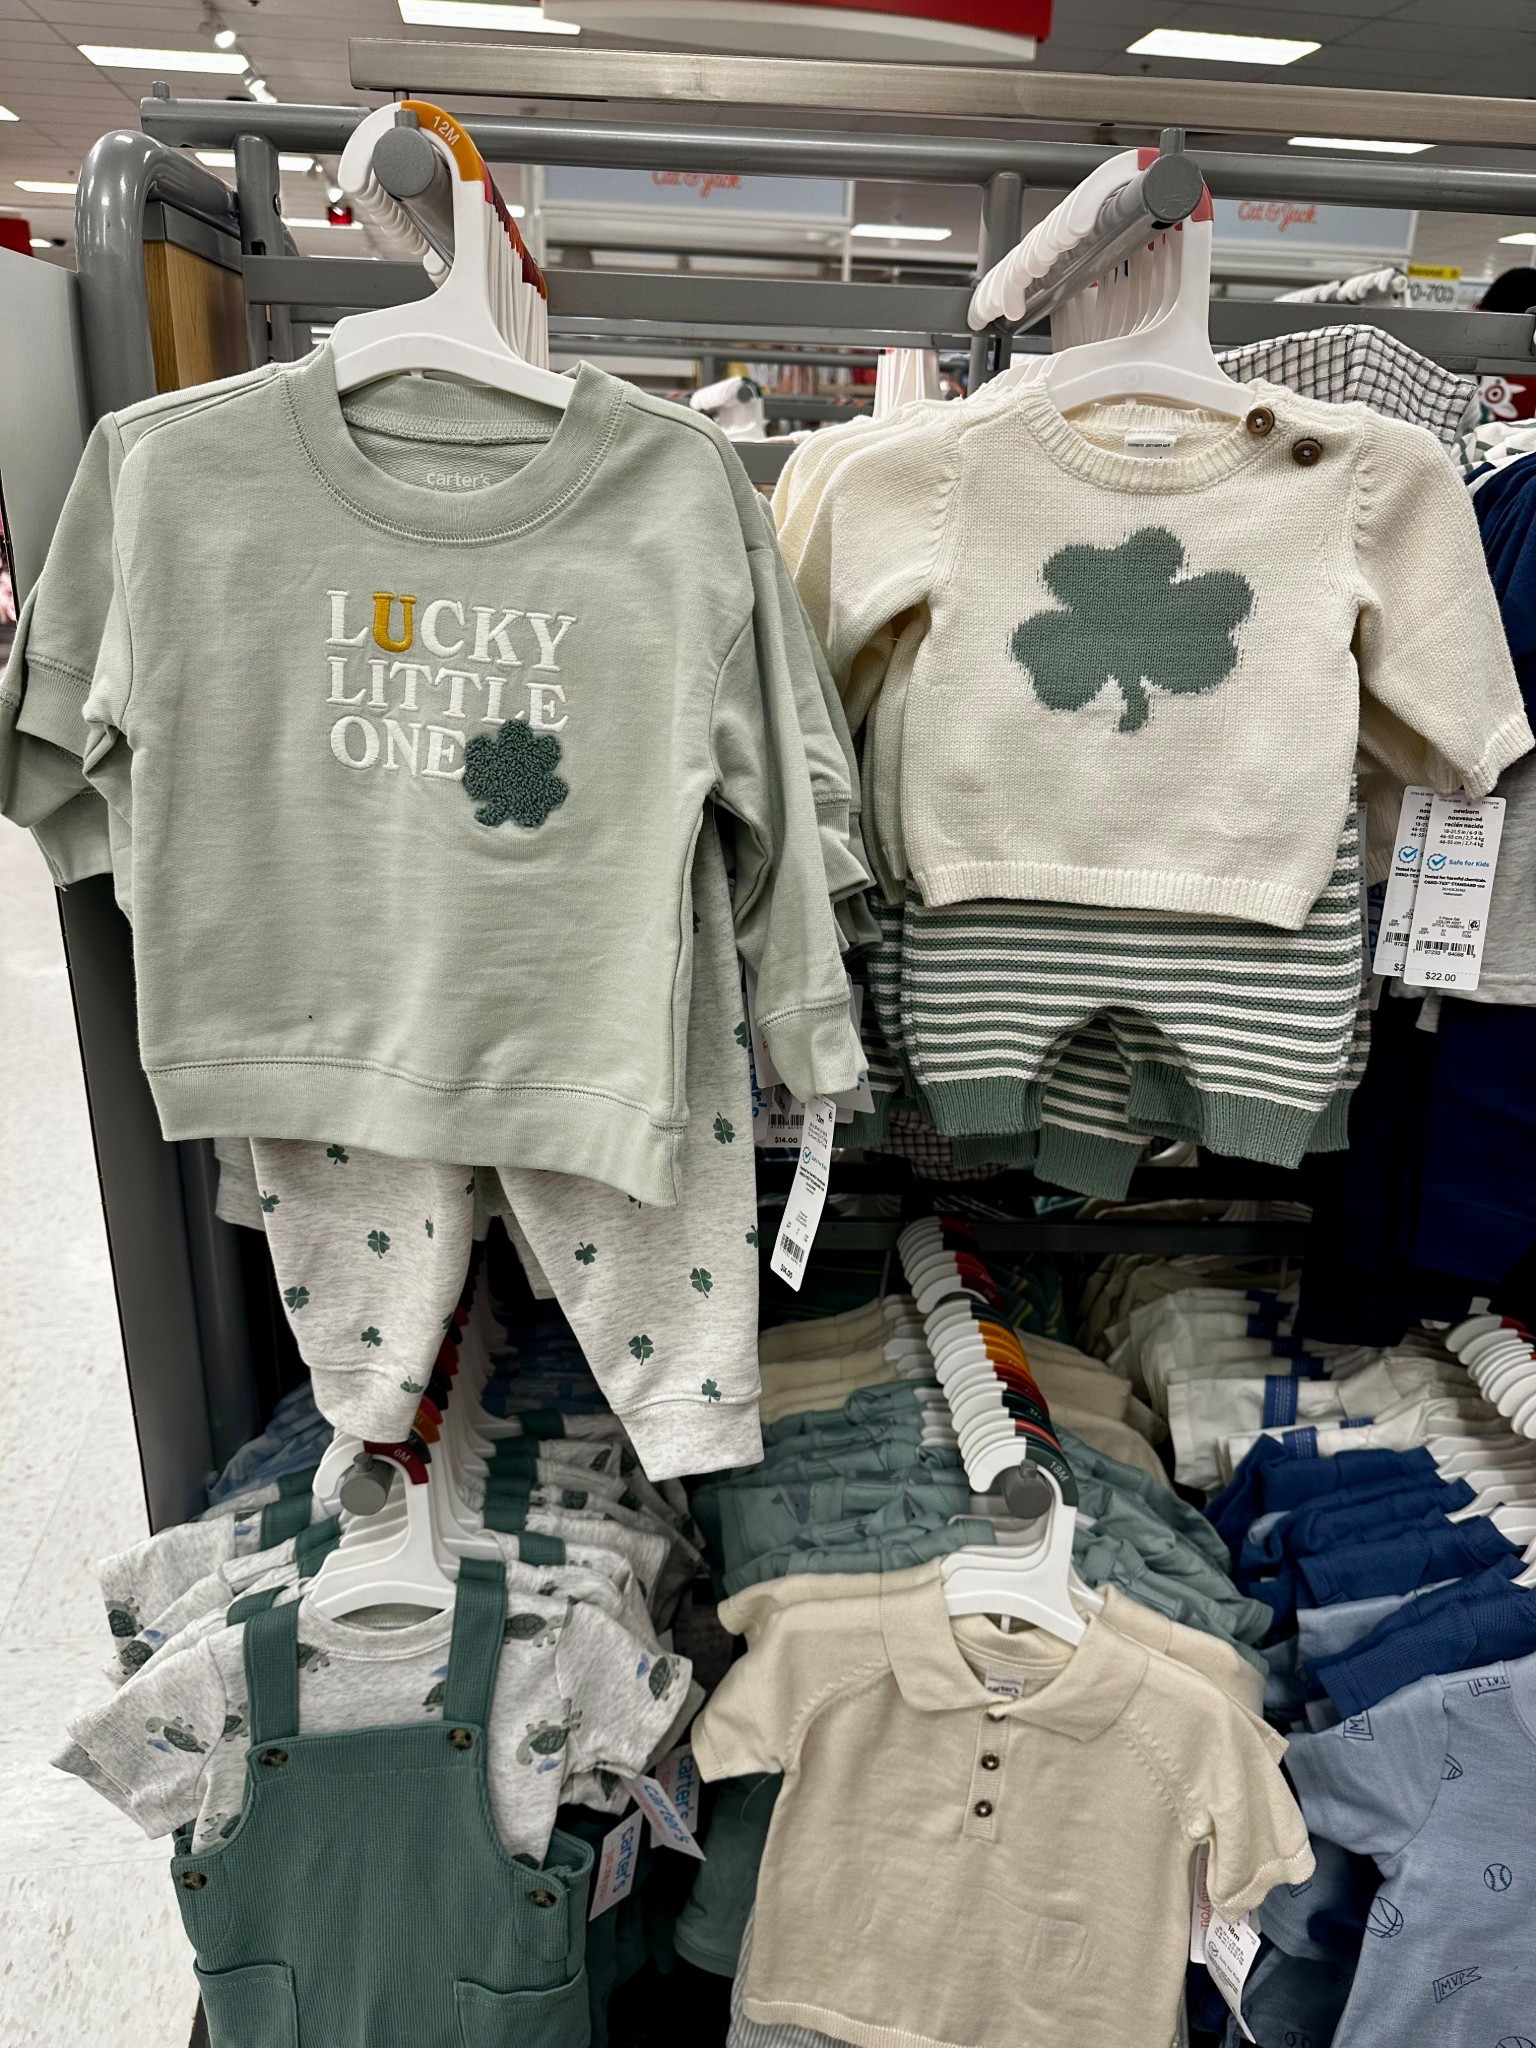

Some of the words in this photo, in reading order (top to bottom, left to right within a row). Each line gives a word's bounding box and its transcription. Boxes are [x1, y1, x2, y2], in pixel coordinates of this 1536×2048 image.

[433, 115, 460, 146] 12M
[426, 472, 491, 488] carter's
[326, 589, 576, 672] LUCKY
[326, 656, 569, 733] LITTLE
[330, 715, 466, 781] ONE
[1425, 972, 1456, 982] $22.00
[774, 1136, 798, 1144] $14.00
[393, 1448, 412, 1463] 6M
[1049, 1461, 1070, 1482] 18M
[644, 1784, 691, 1845] carter's
[612, 1826, 635, 1893] carter's
[1197, 1904, 1211, 1928] you
[1227, 1924, 1240, 1942] 18m
